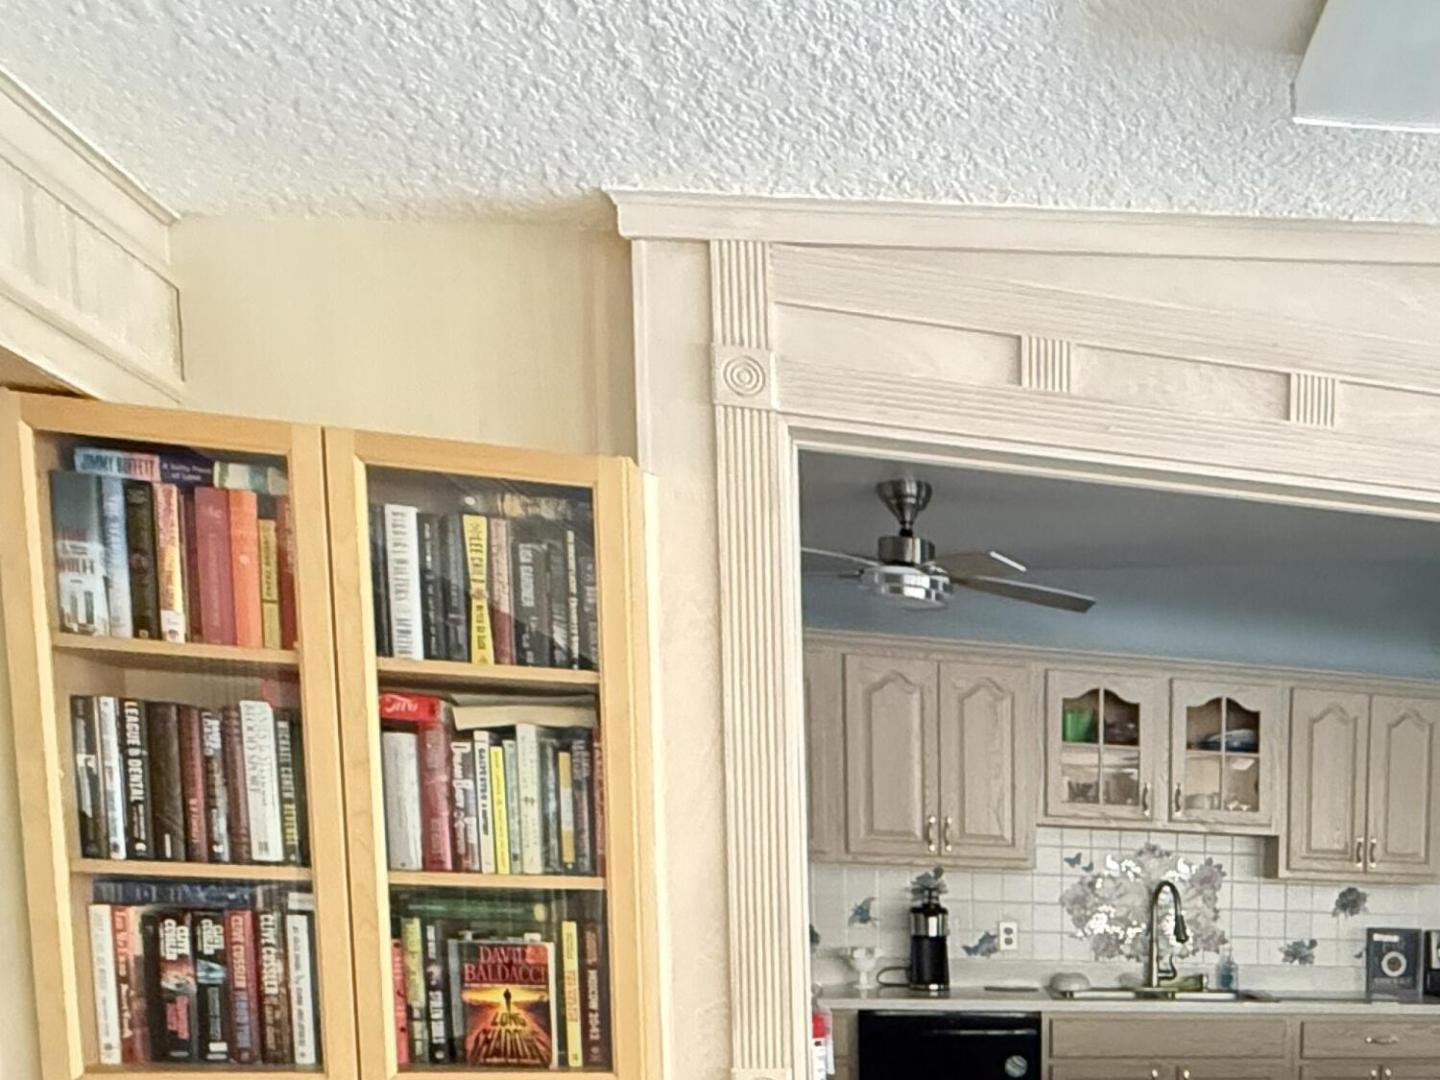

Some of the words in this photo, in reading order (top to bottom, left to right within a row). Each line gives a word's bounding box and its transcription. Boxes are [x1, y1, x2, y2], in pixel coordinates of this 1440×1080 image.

[124, 701, 141, 745] LEAGUE
[128, 759, 144, 802] DENIAL
[230, 915, 243, 944] CLIVE
[261, 914, 277, 946] CLIVE
[232, 945, 246, 988] CUSSLER
[480, 945, 528, 963] DAVID
[262, 947, 280, 995] CUSSLER
[464, 963, 545, 982] BALDACCI
[587, 970, 598, 1010] MOSCOW
[491, 1013, 526, 1027] LONG
[589, 1012, 600, 1040] 2042
